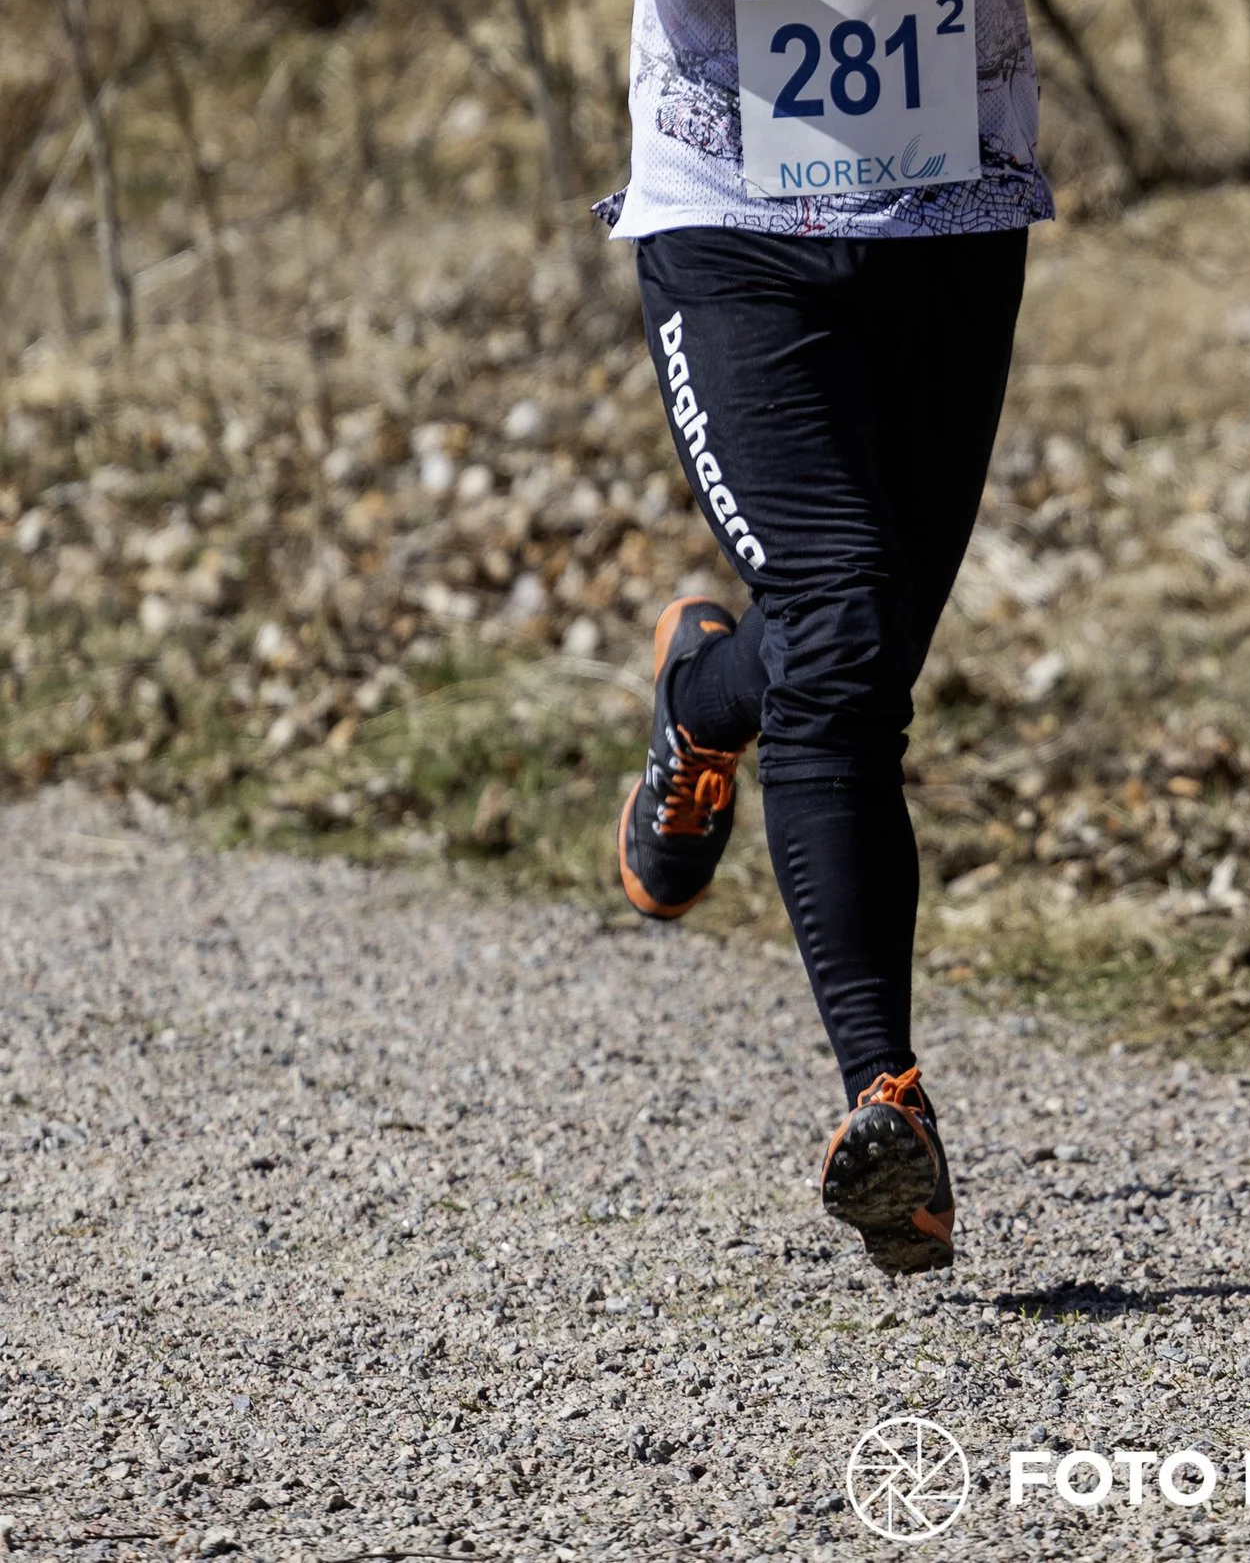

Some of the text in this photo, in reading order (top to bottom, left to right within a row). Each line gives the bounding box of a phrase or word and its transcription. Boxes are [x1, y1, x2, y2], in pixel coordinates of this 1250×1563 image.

[770, 14, 920, 119] 281
[779, 155, 897, 189] NOREX
[659, 310, 767, 571] bagheera
